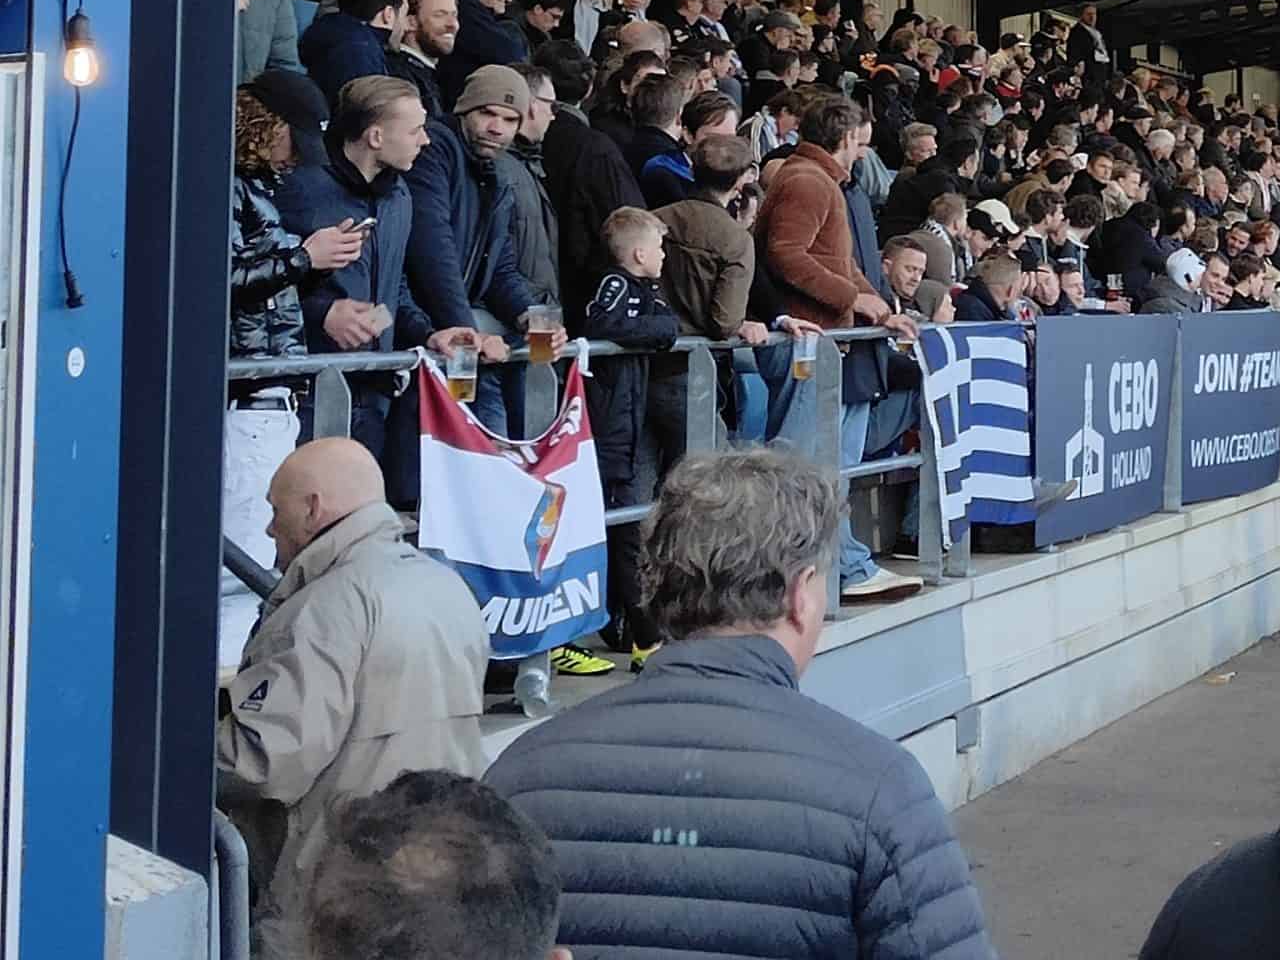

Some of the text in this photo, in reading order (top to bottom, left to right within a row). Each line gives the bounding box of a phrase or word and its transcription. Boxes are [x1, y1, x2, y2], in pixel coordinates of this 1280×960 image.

[1108, 358, 1159, 434] CEBO
[1194, 353, 1239, 394] JOIN
[1111, 445, 1152, 490] HOLLAND
